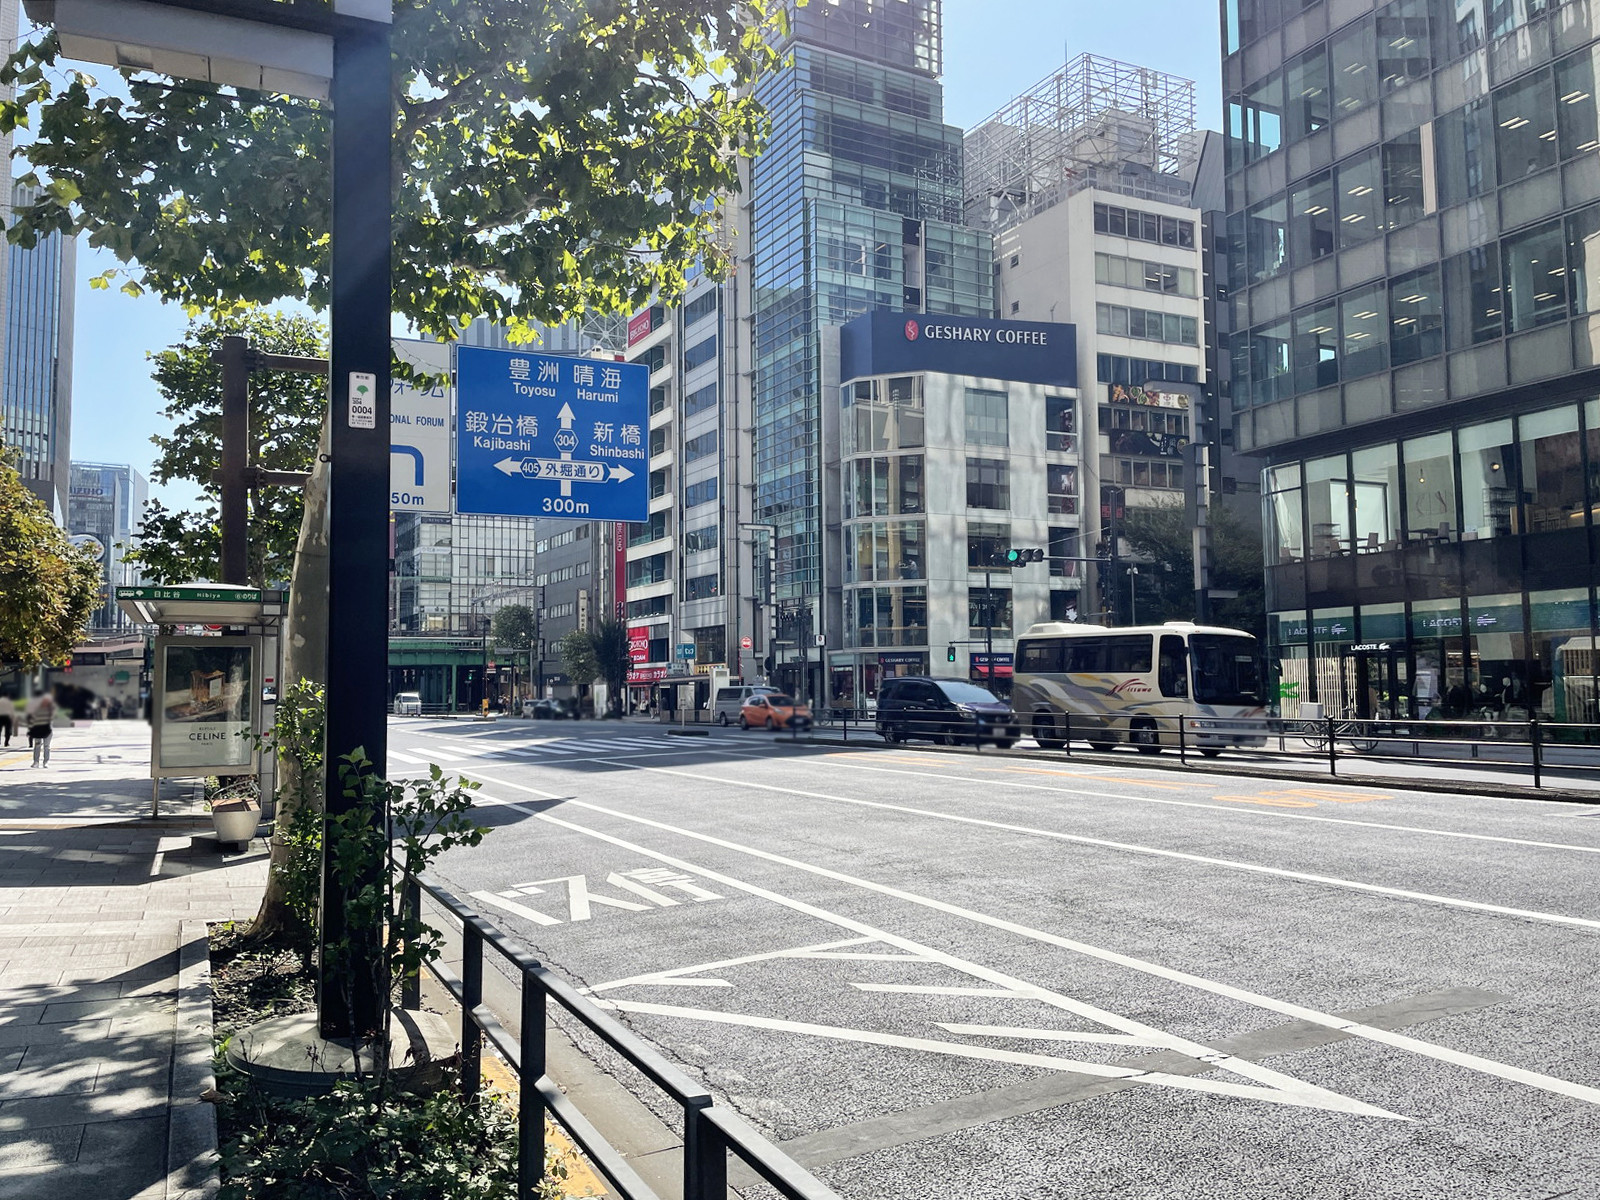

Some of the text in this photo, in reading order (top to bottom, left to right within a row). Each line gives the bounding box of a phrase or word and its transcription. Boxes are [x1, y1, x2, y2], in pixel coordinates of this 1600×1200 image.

[924, 324, 1047, 346] GESHARY COFFEE
[508, 358, 621, 390] 豊洲 晴海
[513, 381, 619, 403] Toyosu Harumi
[351, 405, 373, 415] 0004
[416, 416, 444, 427] FORUM
[465, 410, 538, 438] 鍛冶橋
[557, 434, 575, 446] 304
[593, 421, 642, 446] 新橋
[473, 436, 531, 452] Kajibashi
[590, 444, 645, 460] Shinbashi
[522, 464, 539, 474] 405
[545, 463, 600, 479] 外堀通り
[391, 492, 424, 505] 50m
[542, 498, 589, 514] 300m
[154, 590, 181, 598] 日比谷
[1351, 643, 1377, 651] LACOSTE
[188, 732, 226, 741] CELINE
[468, 867, 726, 926] バス停
